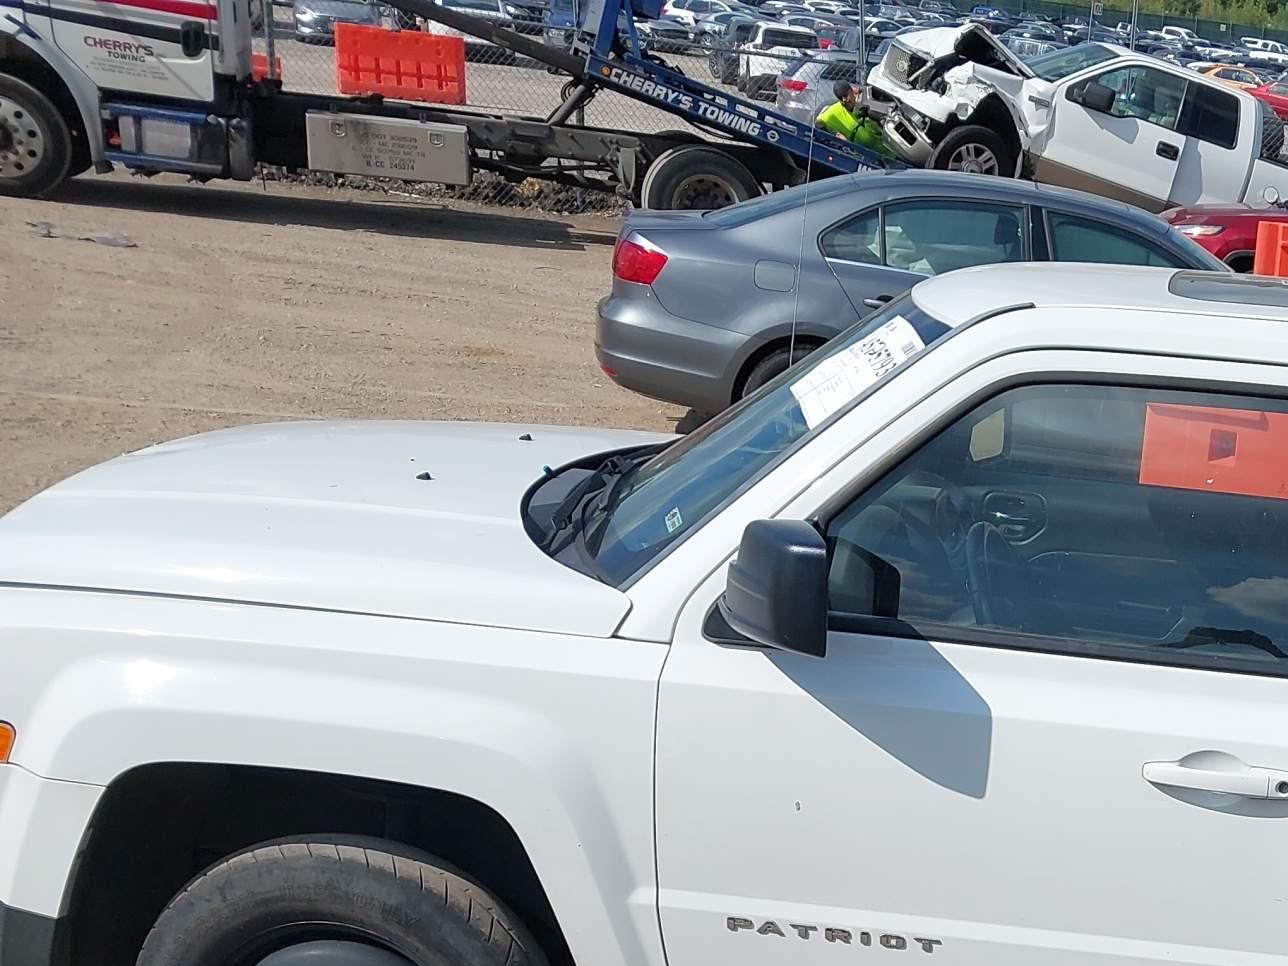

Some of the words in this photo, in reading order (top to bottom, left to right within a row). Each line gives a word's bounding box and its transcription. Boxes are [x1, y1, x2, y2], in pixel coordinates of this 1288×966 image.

[84, 36, 154, 56] CHERRY'S
[107, 50, 146, 63] TOWING
[610, 67, 693, 111] CHERRY'S
[696, 102, 761, 135] TOWING
[726, 916, 943, 953] PATRIOT
